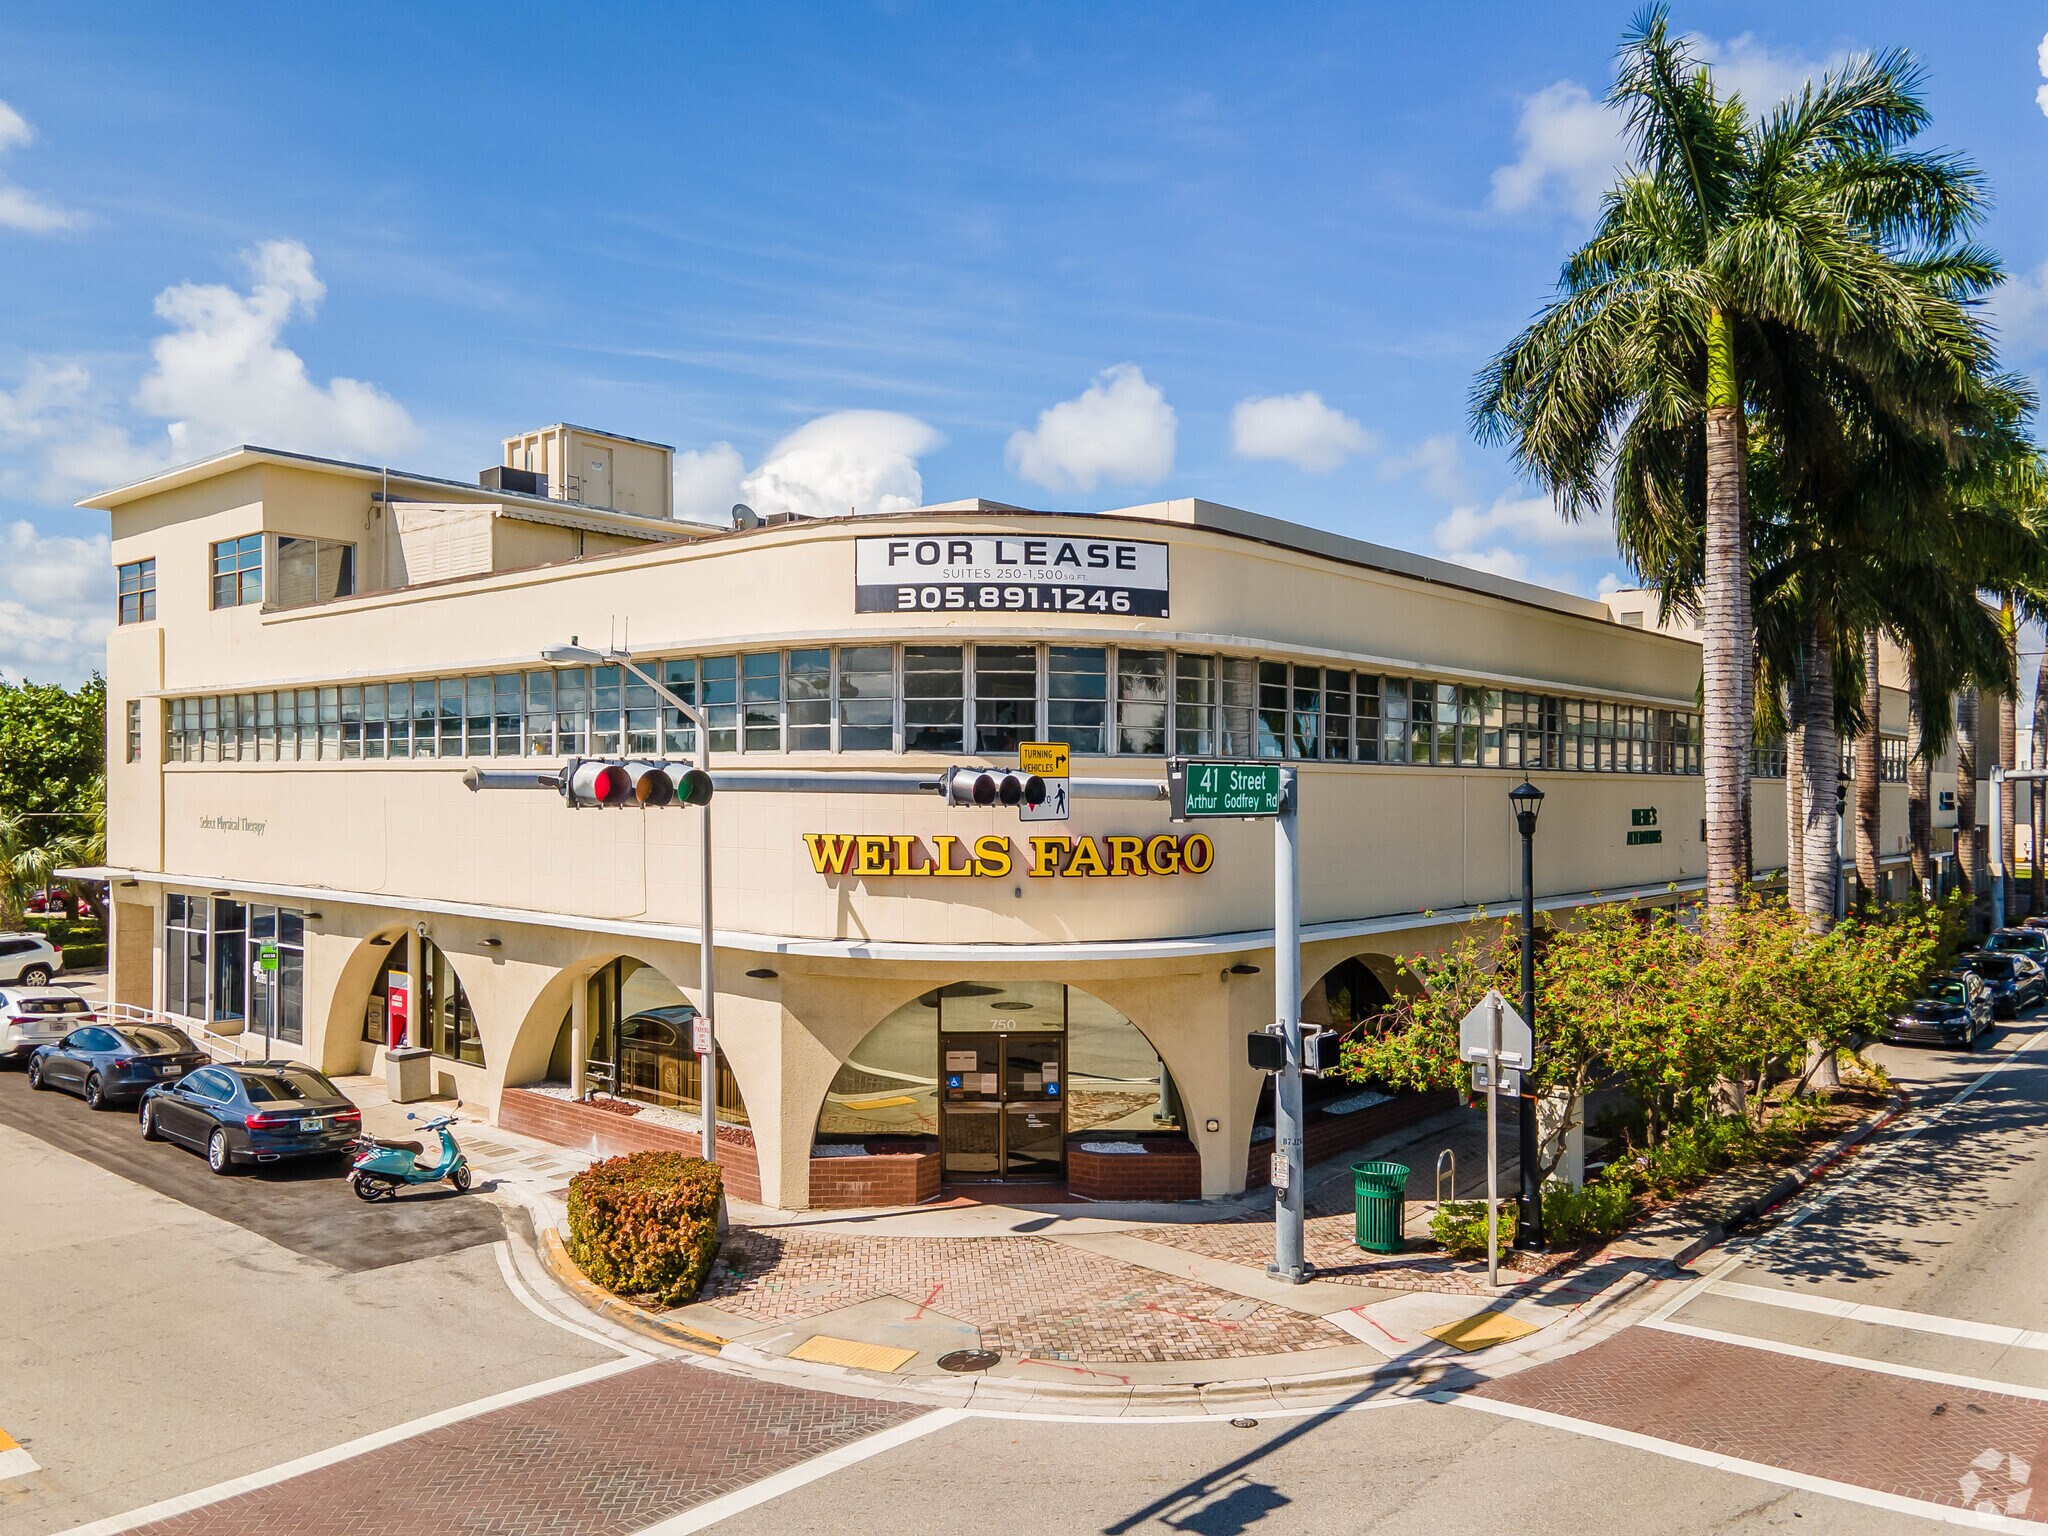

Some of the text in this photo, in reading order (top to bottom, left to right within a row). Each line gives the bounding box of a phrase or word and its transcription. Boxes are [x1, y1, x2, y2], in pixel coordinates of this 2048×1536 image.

[888, 540, 1136, 570] FOR LEASE
[943, 569, 991, 579] SUITES
[897, 586, 1131, 612] 305.891.1246
[1024, 749, 1053, 759] TURNING
[1023, 763, 1054, 773] VEHICLES
[1200, 767, 1267, 793] 41 Street
[1187, 793, 1278, 812] Arthur Godfrey Rd
[199, 815, 265, 836] Select Physical Therapy
[802, 833, 1215, 878] WELLS FARGO
[990, 1019, 1017, 1031] 750
